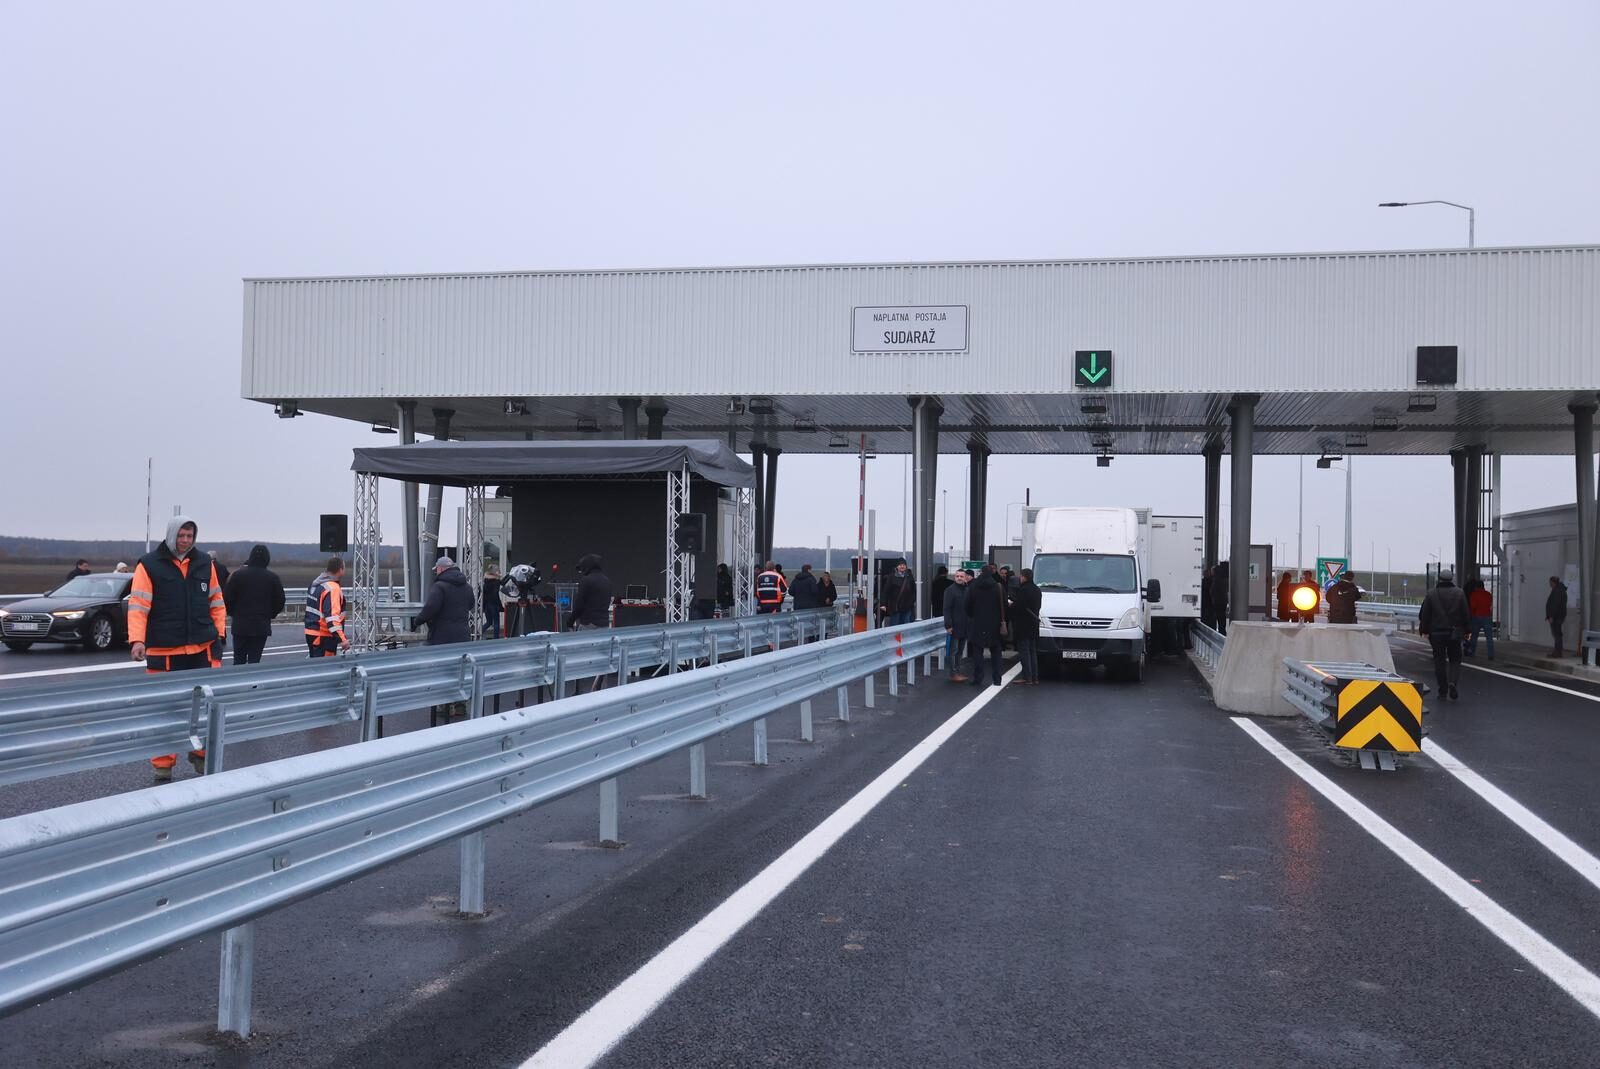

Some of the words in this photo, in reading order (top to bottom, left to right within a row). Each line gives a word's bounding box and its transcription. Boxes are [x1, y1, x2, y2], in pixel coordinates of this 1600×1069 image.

[873, 313, 909, 321] NAPLATNA
[915, 312, 946, 321] POSTAJA
[884, 328, 935, 344] SUDARAŽ
